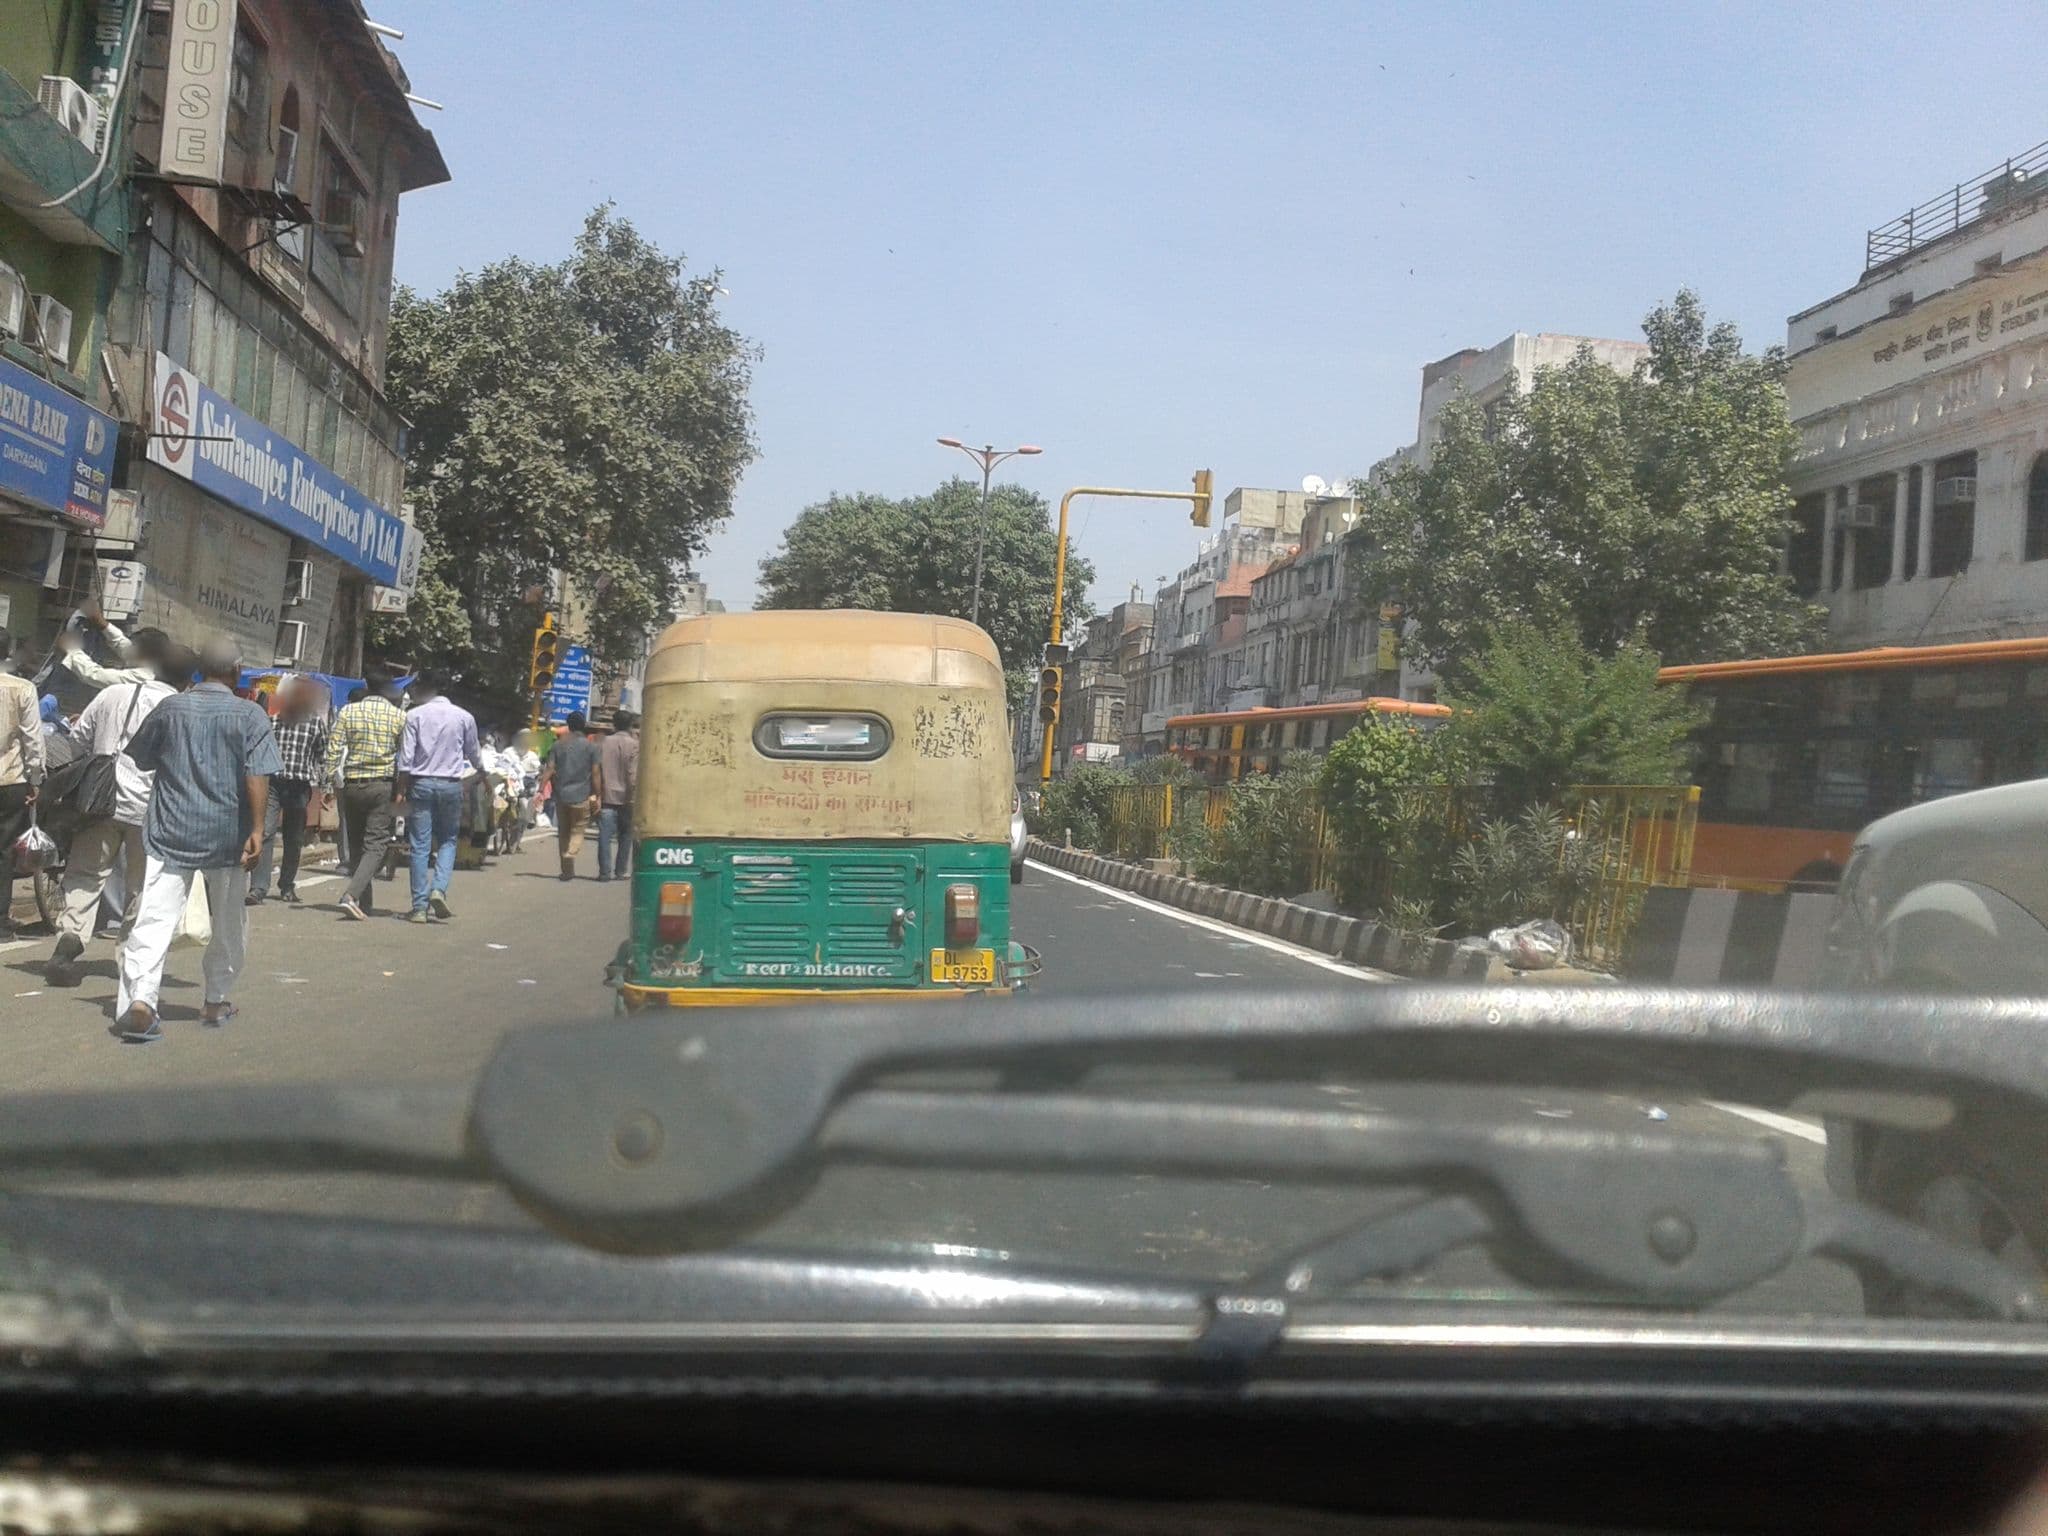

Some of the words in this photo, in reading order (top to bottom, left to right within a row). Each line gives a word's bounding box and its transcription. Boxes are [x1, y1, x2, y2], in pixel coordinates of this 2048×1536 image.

[0, 382, 30, 428] ENA
[32, 399, 68, 446] BANK
[291, 456, 360, 543] Enterprises
[377, 517, 399, 567] Ltd.
[198, 584, 276, 627] HIMALAYA
[656, 848, 694, 864] CNG
[944, 967, 988, 981] L9753
